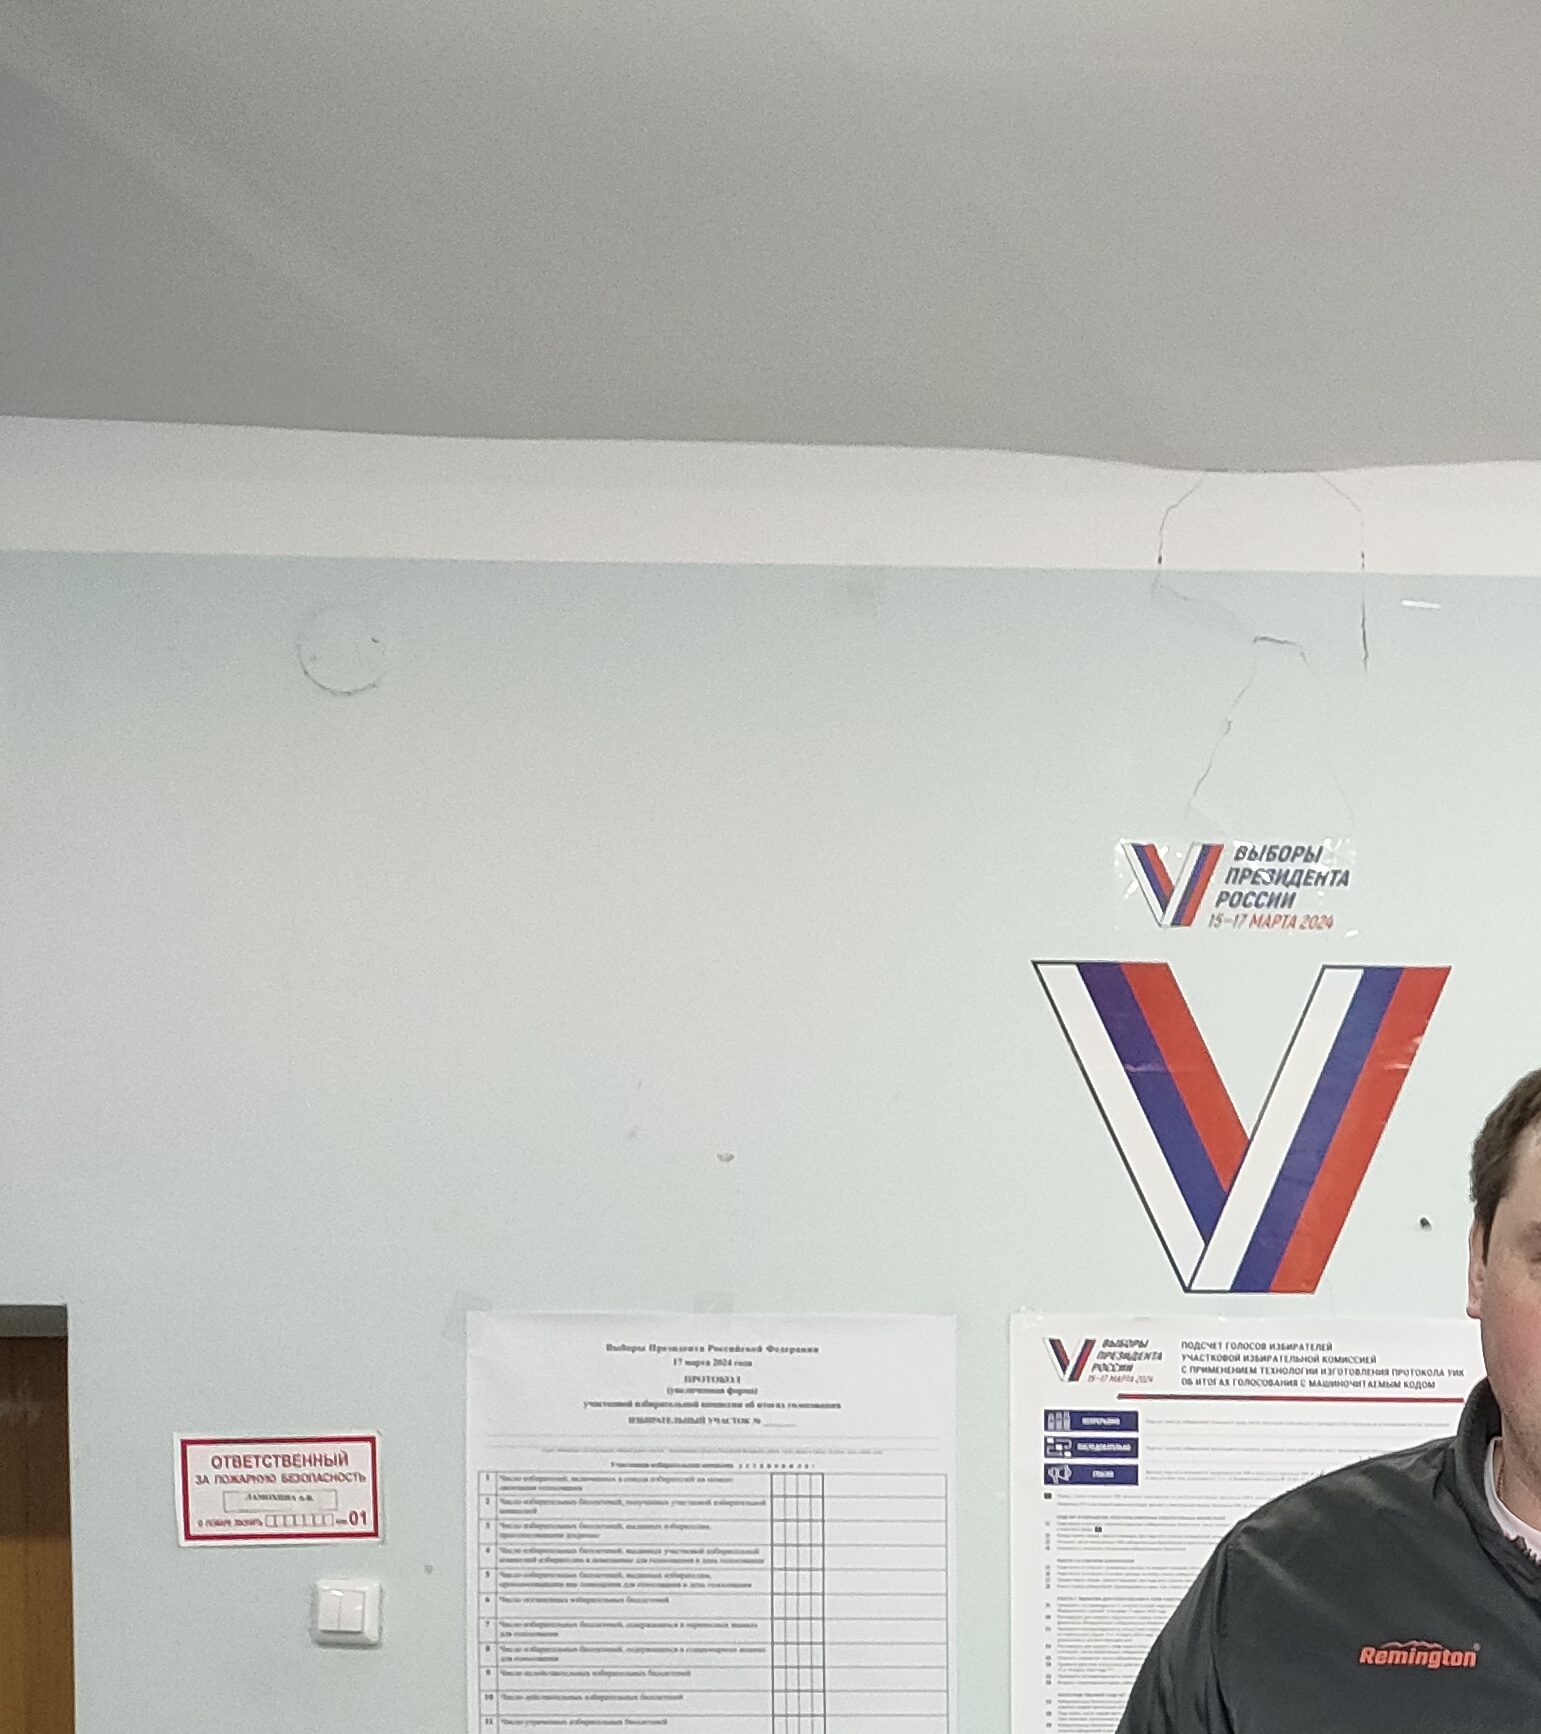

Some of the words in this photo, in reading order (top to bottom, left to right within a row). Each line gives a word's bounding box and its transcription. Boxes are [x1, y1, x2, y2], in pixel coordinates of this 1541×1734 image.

[1233, 844, 1323, 864] ВЫБОРЫ
[1224, 867, 1350, 888] ПРЕЗИДЕНТА
[1215, 891, 1296, 909] РОССИИ
[1249, 913, 1296, 930] МАРТА
[1299, 913, 1334, 930] 2024
[1181, 1340, 1223, 1351] ПОДСЧЕТ
[1226, 1341, 1267, 1351] ГОЛОСОВ
[1269, 1341, 1333, 1352] ИЗБИРАТЕЛЕЙ
[1181, 1353, 1241, 1364] УЧАСТКОВОЙ
[1243, 1354, 1320, 1364] ИЗБИРАТЕЛЬНОЙ
[211, 1450, 349, 1469] ОТВЕТСТВЕННЫЙ
[195, 1474, 209, 1485] ЗА
[214, 1473, 276, 1485] ПОЖАРНУЮ
[281, 1471, 367, 1484] БЕЗОПАСНОСТЬ
[349, 1510, 367, 1525] 01
[1360, 1646, 1477, 1669] Remington
